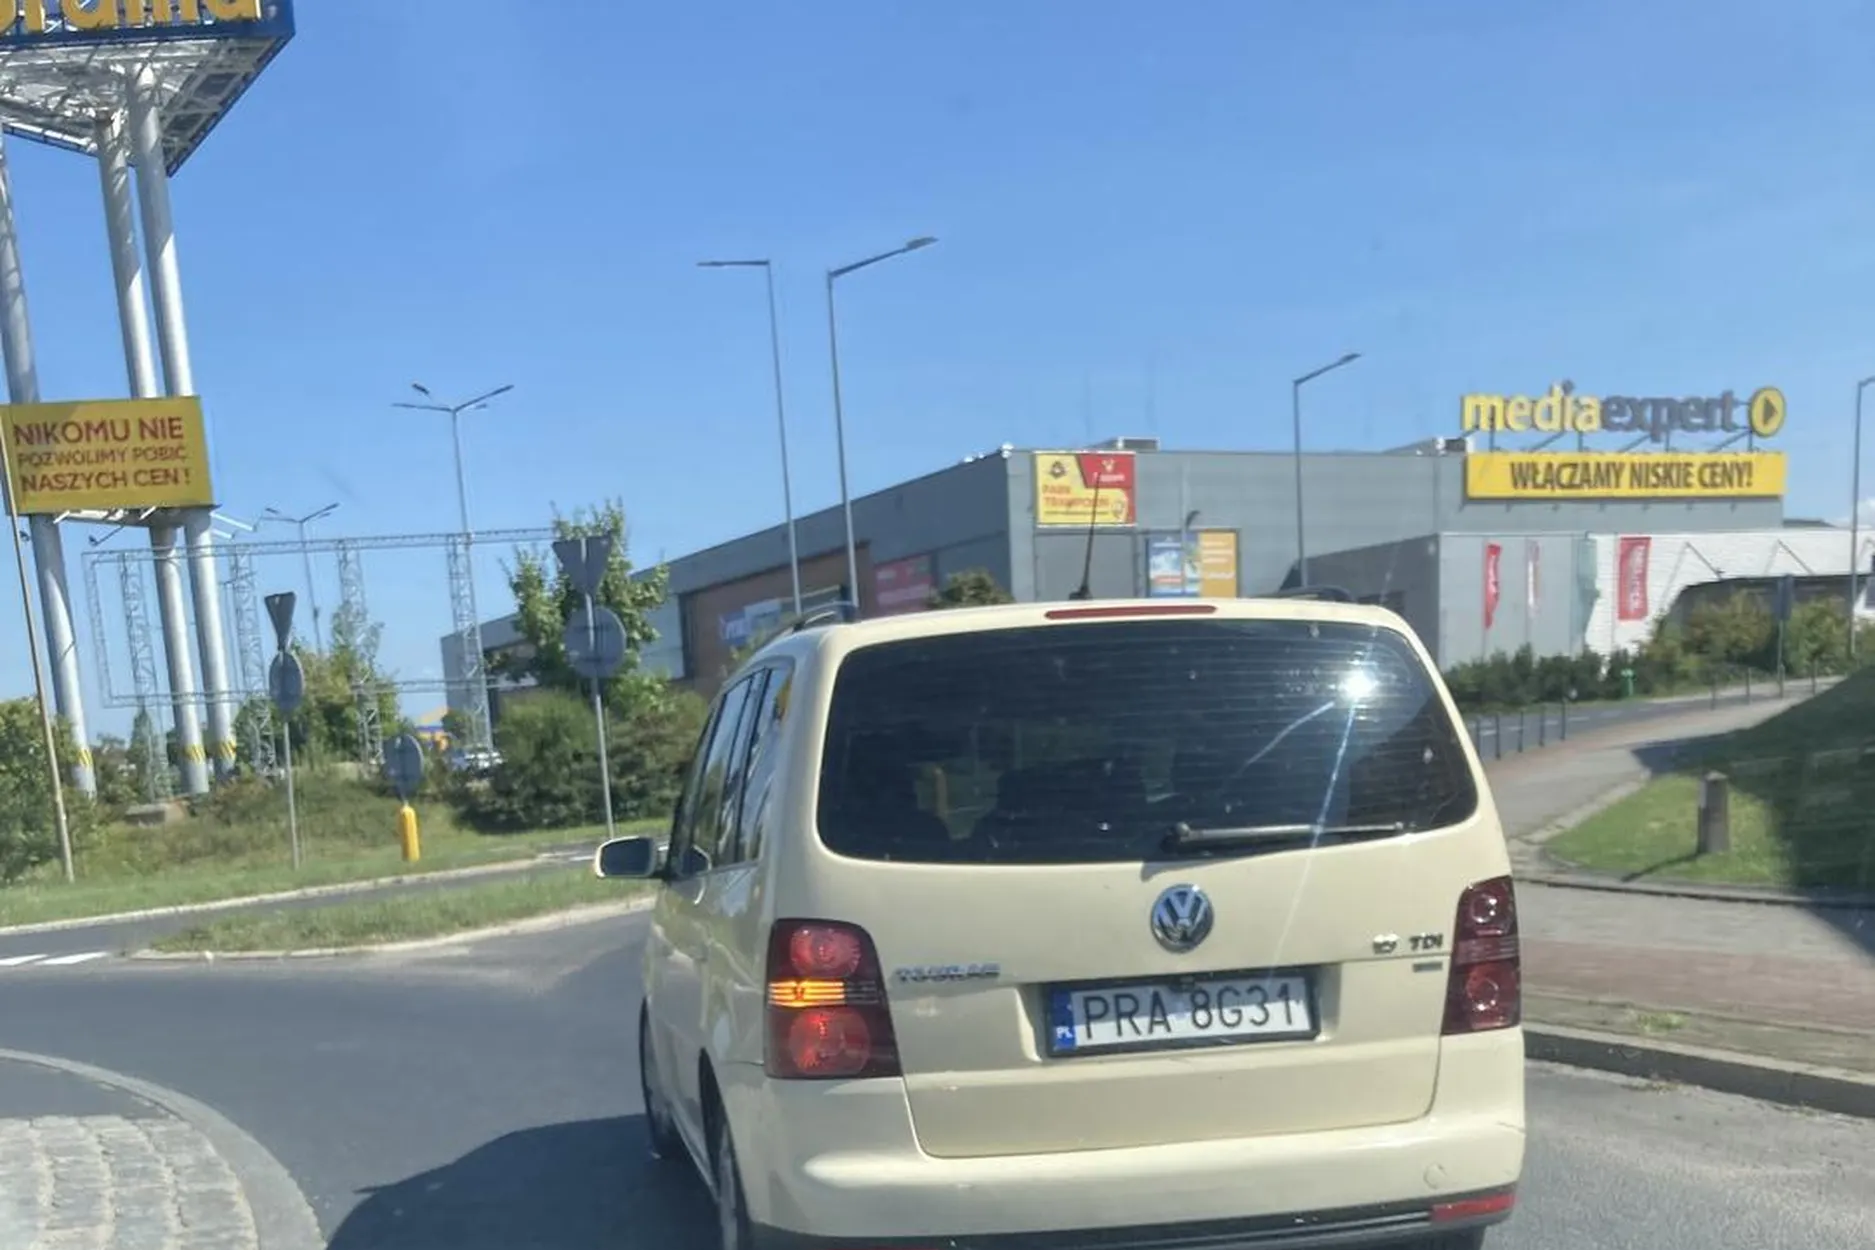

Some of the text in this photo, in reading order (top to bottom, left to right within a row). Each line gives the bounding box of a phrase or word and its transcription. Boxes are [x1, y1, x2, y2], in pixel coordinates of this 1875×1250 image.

[1461, 380, 1738, 442] mediaexpert
[14, 416, 184, 445] NIKOMU NIE
[18, 447, 128, 468] POZWOLIMY
[22, 471, 128, 492] NASZYCH
[1511, 461, 1754, 492] WŁĄCZAMY NISKIE CENY!
[1082, 982, 1294, 1039] PRA 8G31
